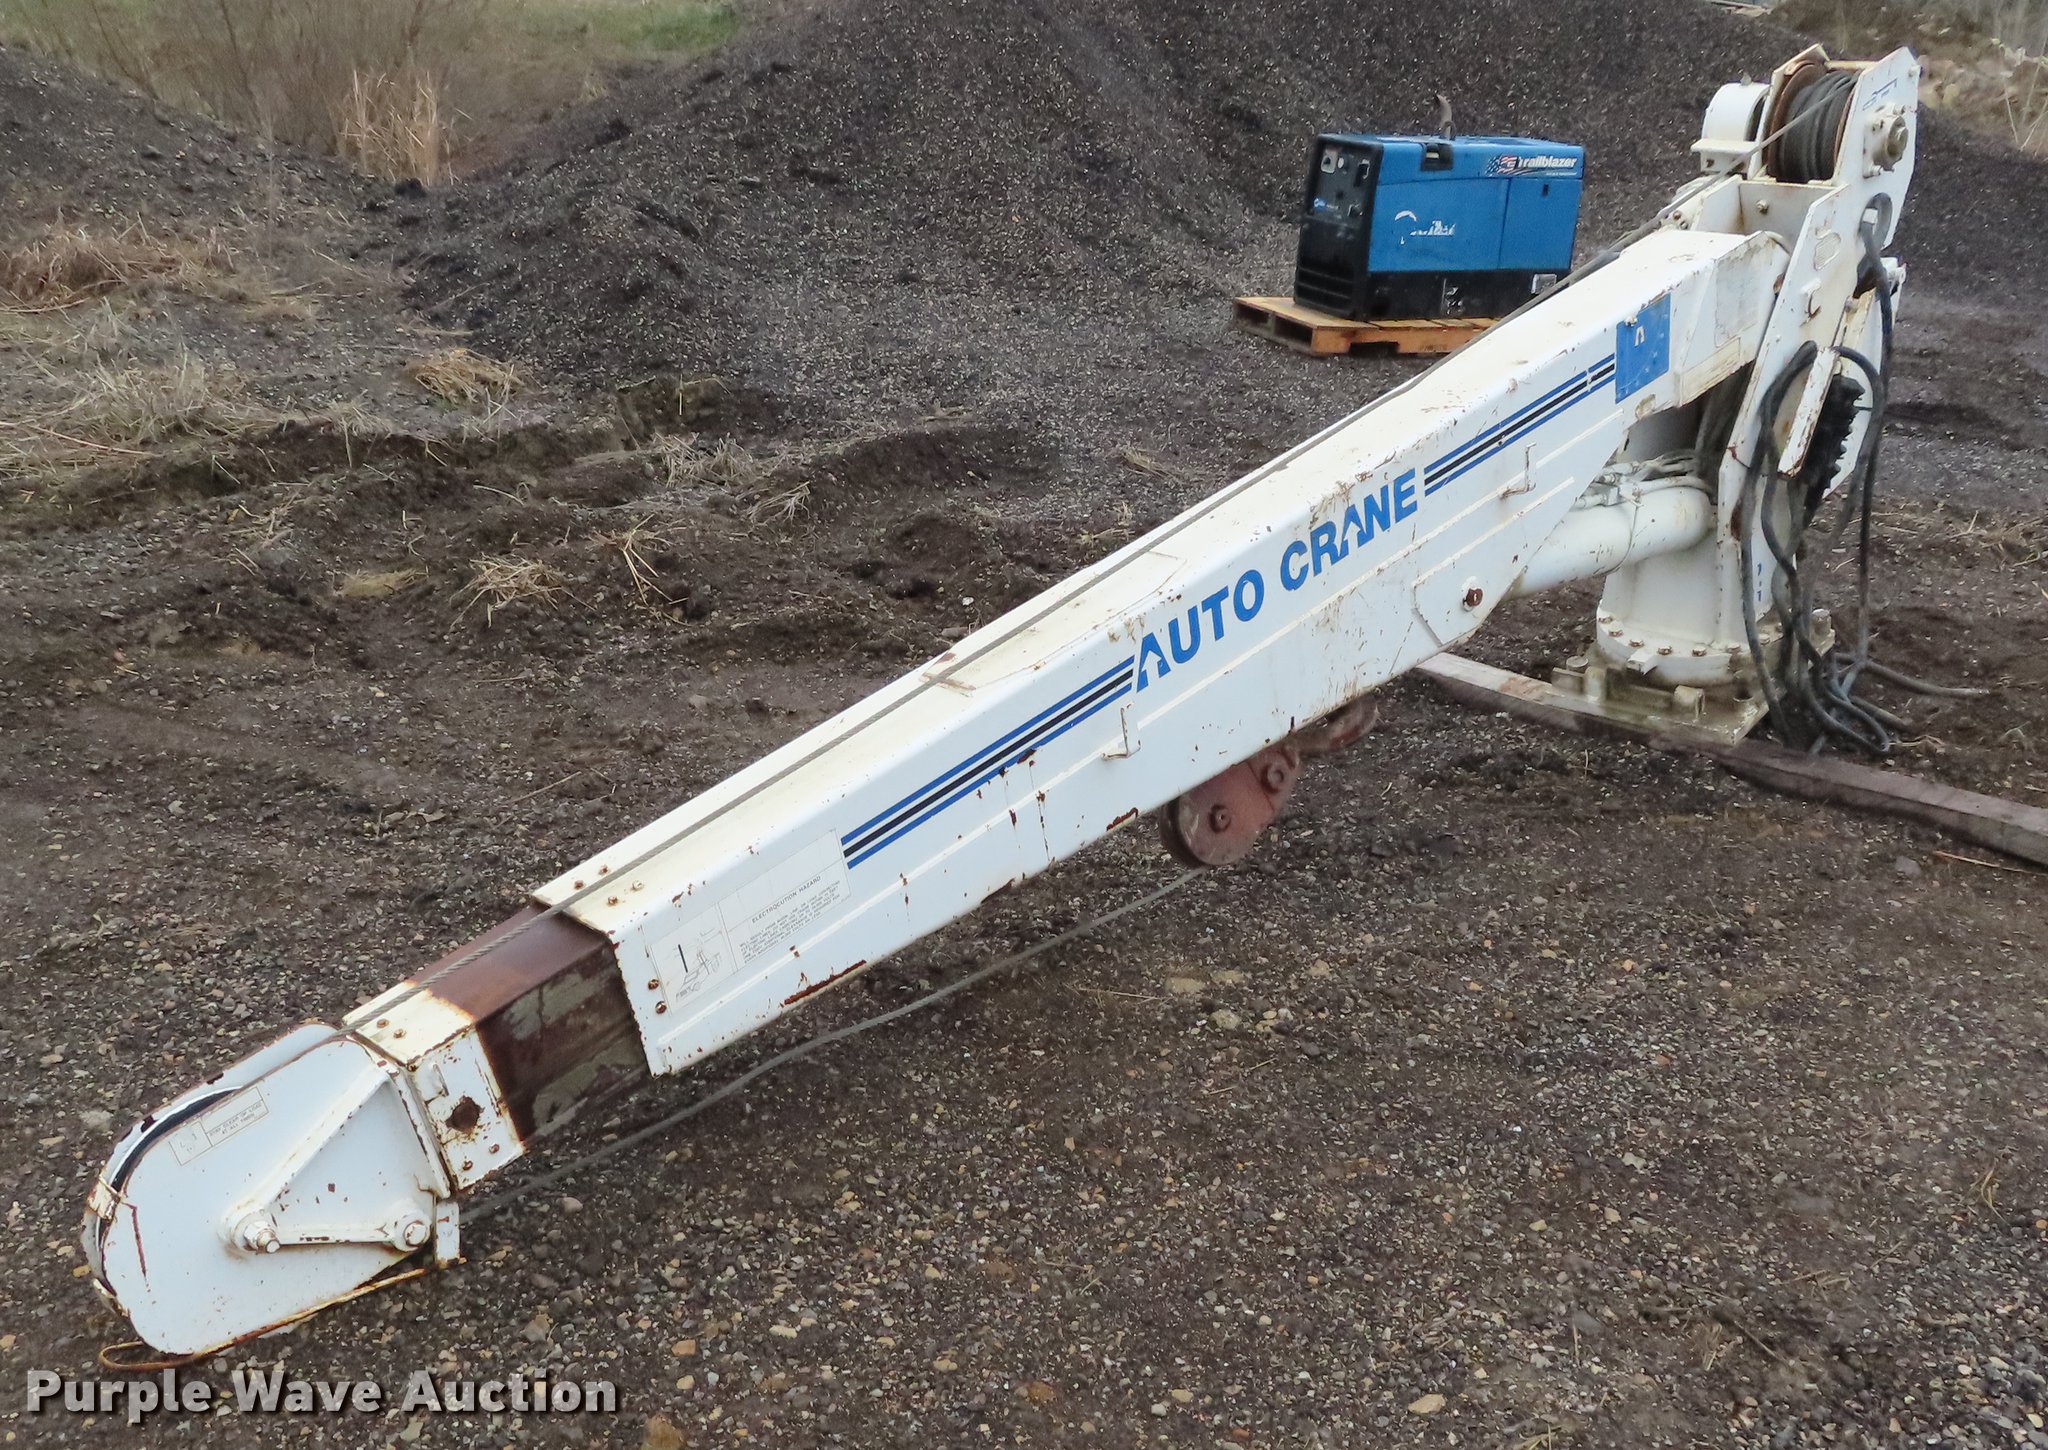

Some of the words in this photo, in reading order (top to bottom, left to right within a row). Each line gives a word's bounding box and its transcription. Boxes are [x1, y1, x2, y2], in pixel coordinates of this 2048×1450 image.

[1136, 569, 1265, 693] AUTO
[1280, 468, 1418, 591] CRANE
[752, 892, 798, 923] ELECTROCUTION
[799, 875, 821, 893] HAZARD
